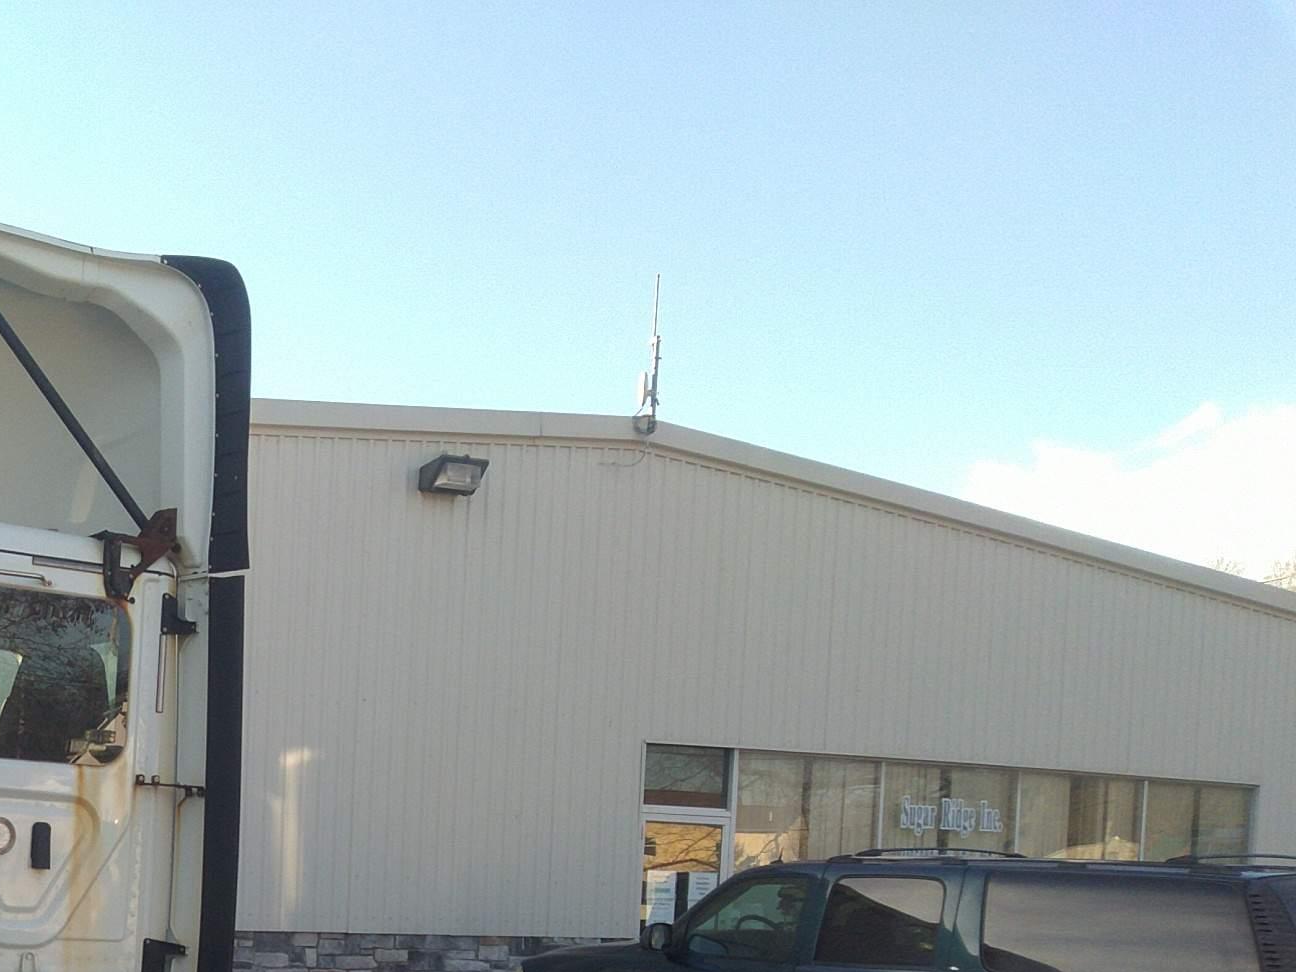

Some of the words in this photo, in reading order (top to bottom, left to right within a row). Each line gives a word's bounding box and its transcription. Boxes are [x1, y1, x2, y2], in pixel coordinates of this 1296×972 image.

[900, 795, 938, 836] Sugar
[940, 797, 976, 838] Ridge
[979, 800, 1004, 833] Inc.
